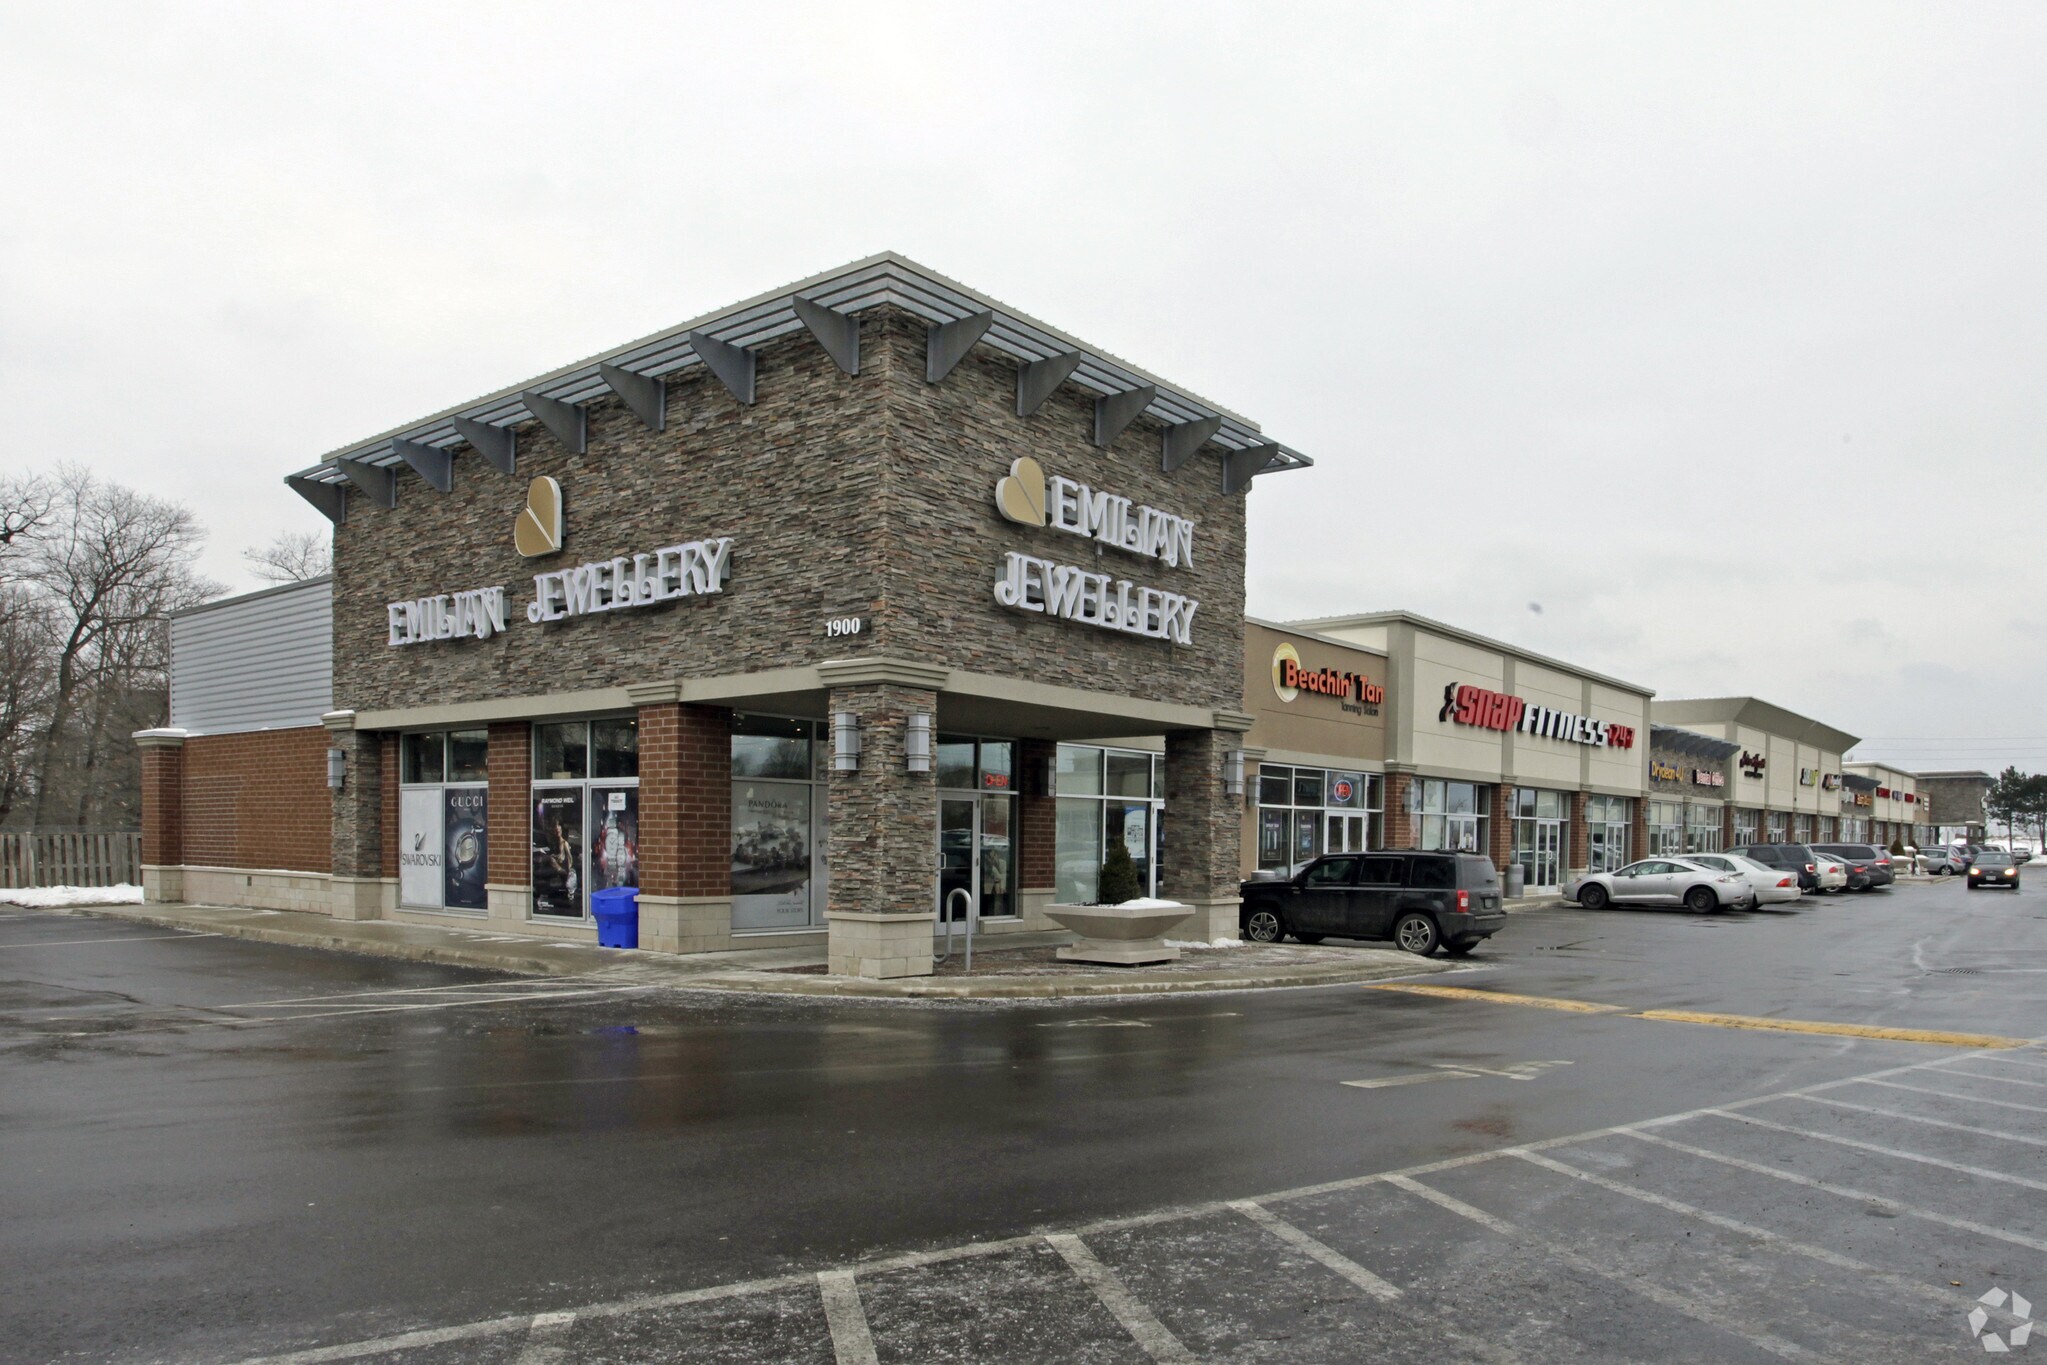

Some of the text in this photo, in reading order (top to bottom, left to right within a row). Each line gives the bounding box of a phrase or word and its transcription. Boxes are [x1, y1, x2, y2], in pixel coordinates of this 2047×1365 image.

[1049, 475, 1195, 568] EMILIAN
[387, 537, 735, 646] EMILIAN JEWELLERY
[994, 551, 1200, 646] JEWELLERY
[825, 617, 861, 637] 1900
[1283, 658, 1385, 704] Beachin' Tan
[1340, 701, 1362, 716] Tanning
[1519, 702, 1611, 747] FITNESS
[451, 795, 483, 808] GUCCI
[402, 853, 442, 867] SWAROVSKI
